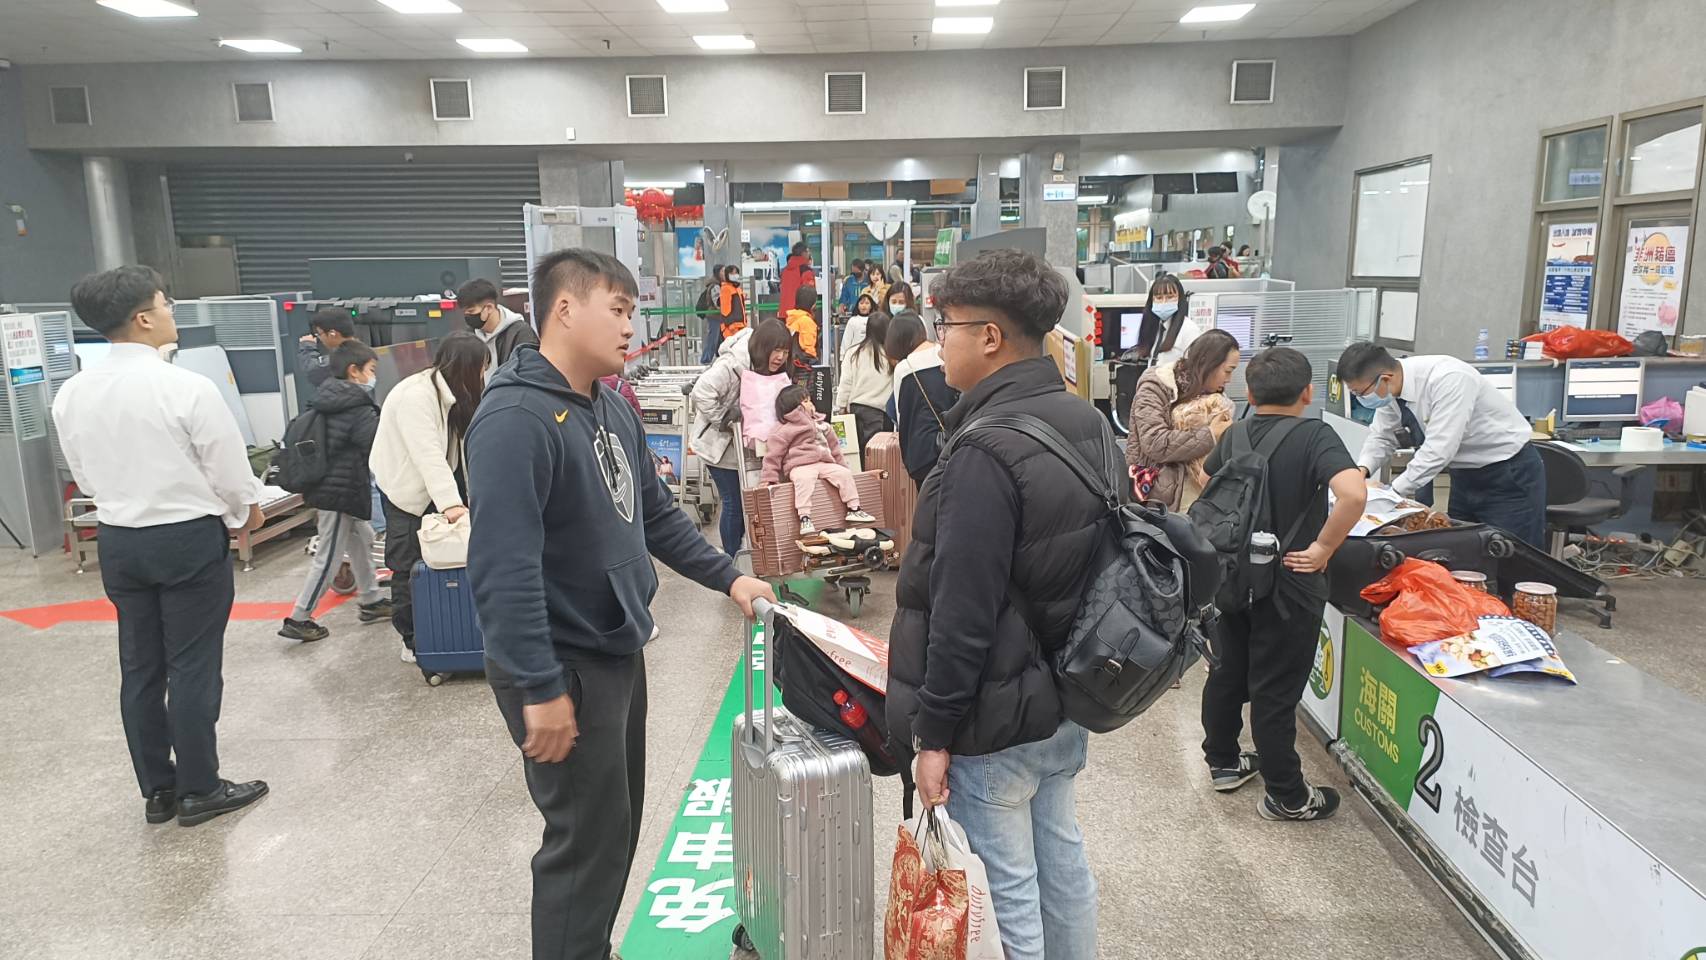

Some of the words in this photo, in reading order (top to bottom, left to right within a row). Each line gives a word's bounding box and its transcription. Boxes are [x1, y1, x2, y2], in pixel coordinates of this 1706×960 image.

[816, 371, 825, 401] dutyfree
[1359, 666, 1398, 735] 海關
[1354, 707, 1399, 764] CUSTOMS
[1414, 714, 1444, 814] 2
[1453, 785, 1539, 909] 檢查台
[647, 777, 736, 933] 免申報
